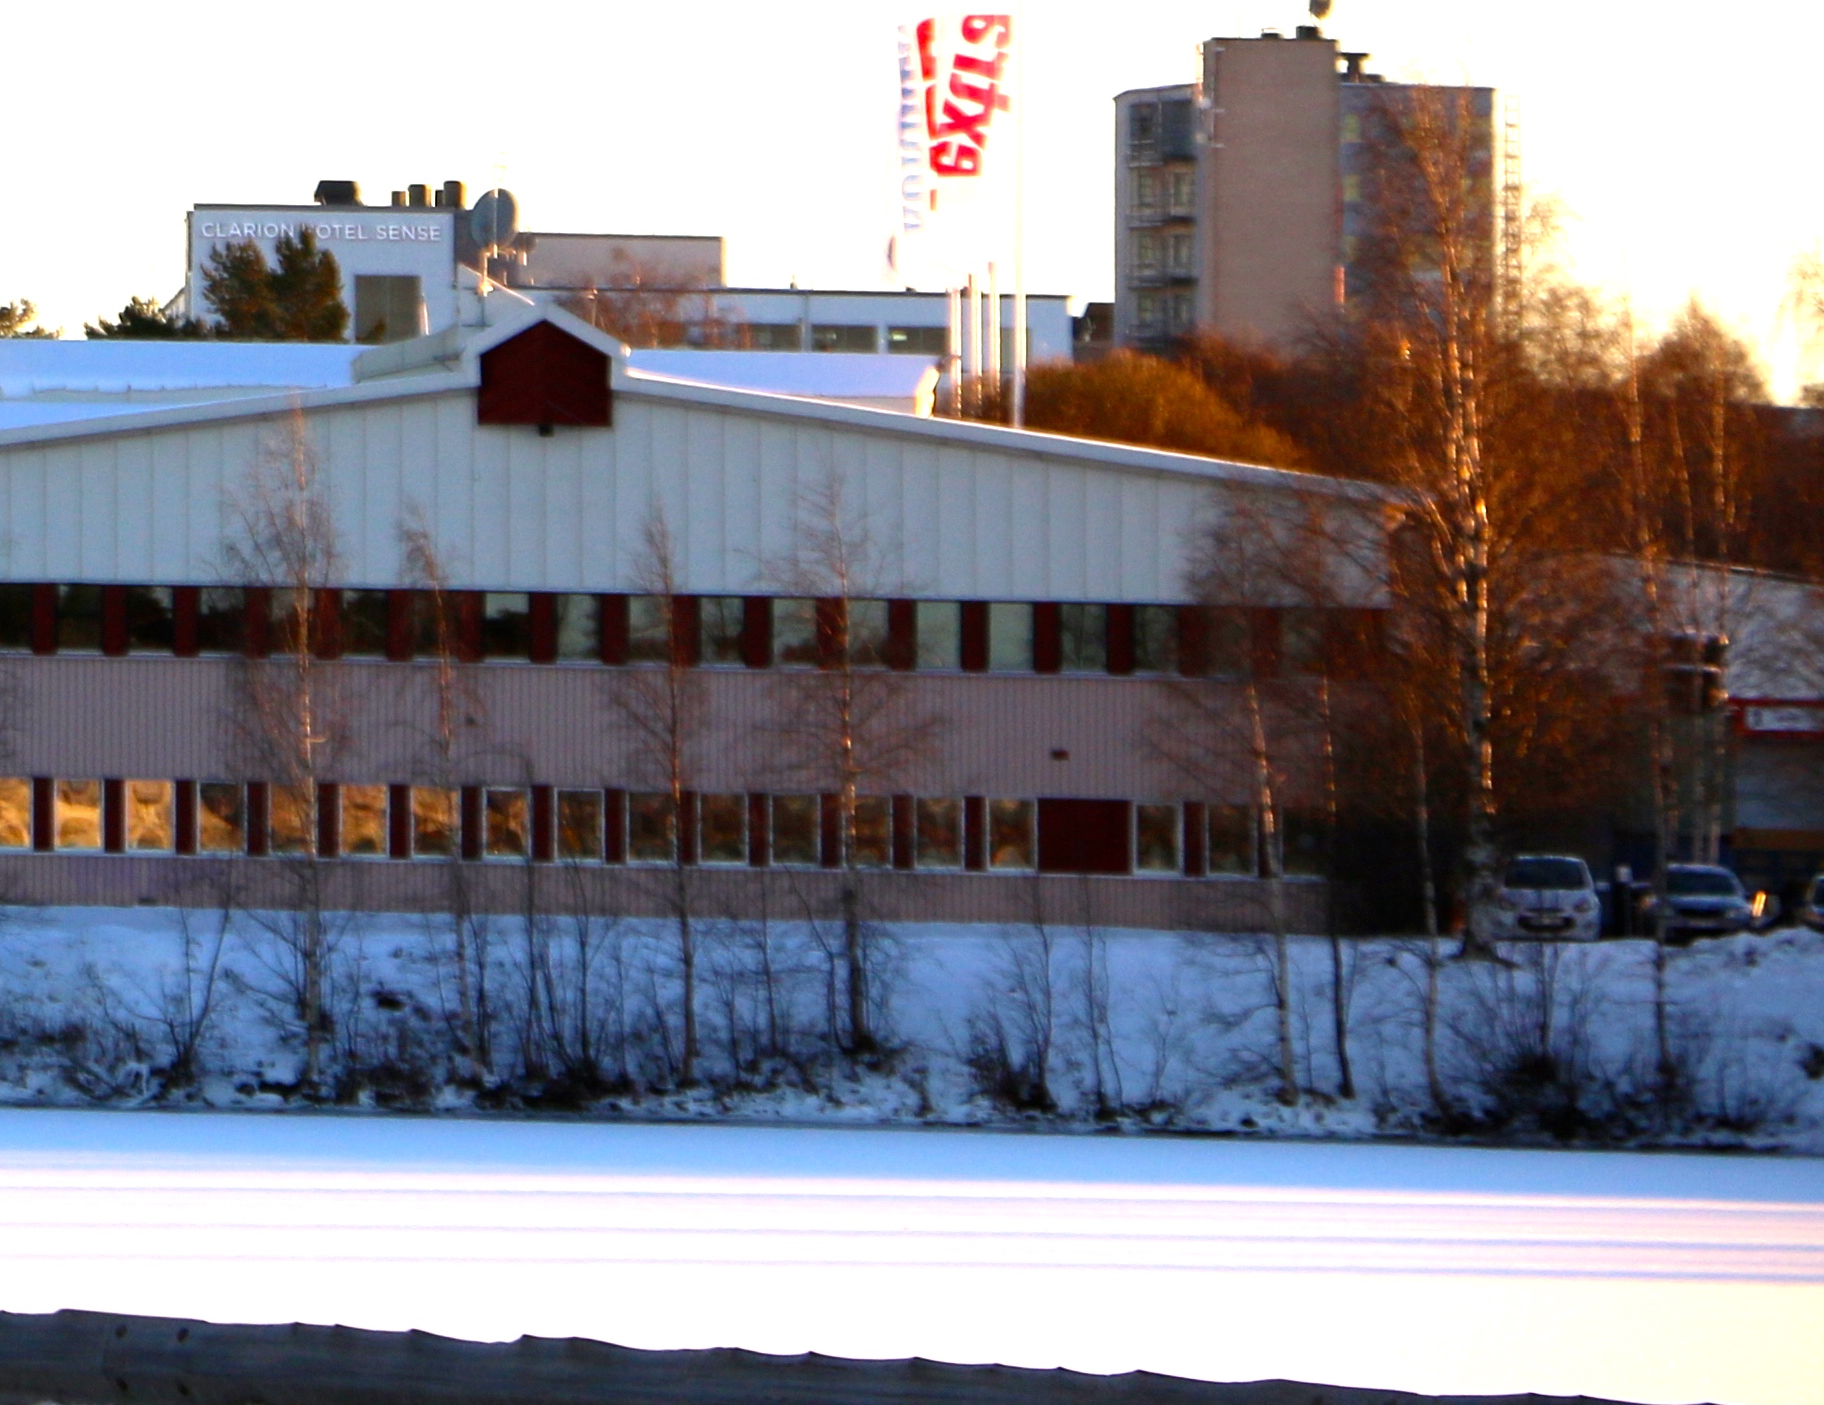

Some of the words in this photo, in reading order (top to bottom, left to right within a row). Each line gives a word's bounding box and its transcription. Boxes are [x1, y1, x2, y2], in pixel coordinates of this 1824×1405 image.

[202, 222, 294, 239] CLARION
[301, 223, 367, 240] OTEL
[376, 224, 442, 242] SENSE
